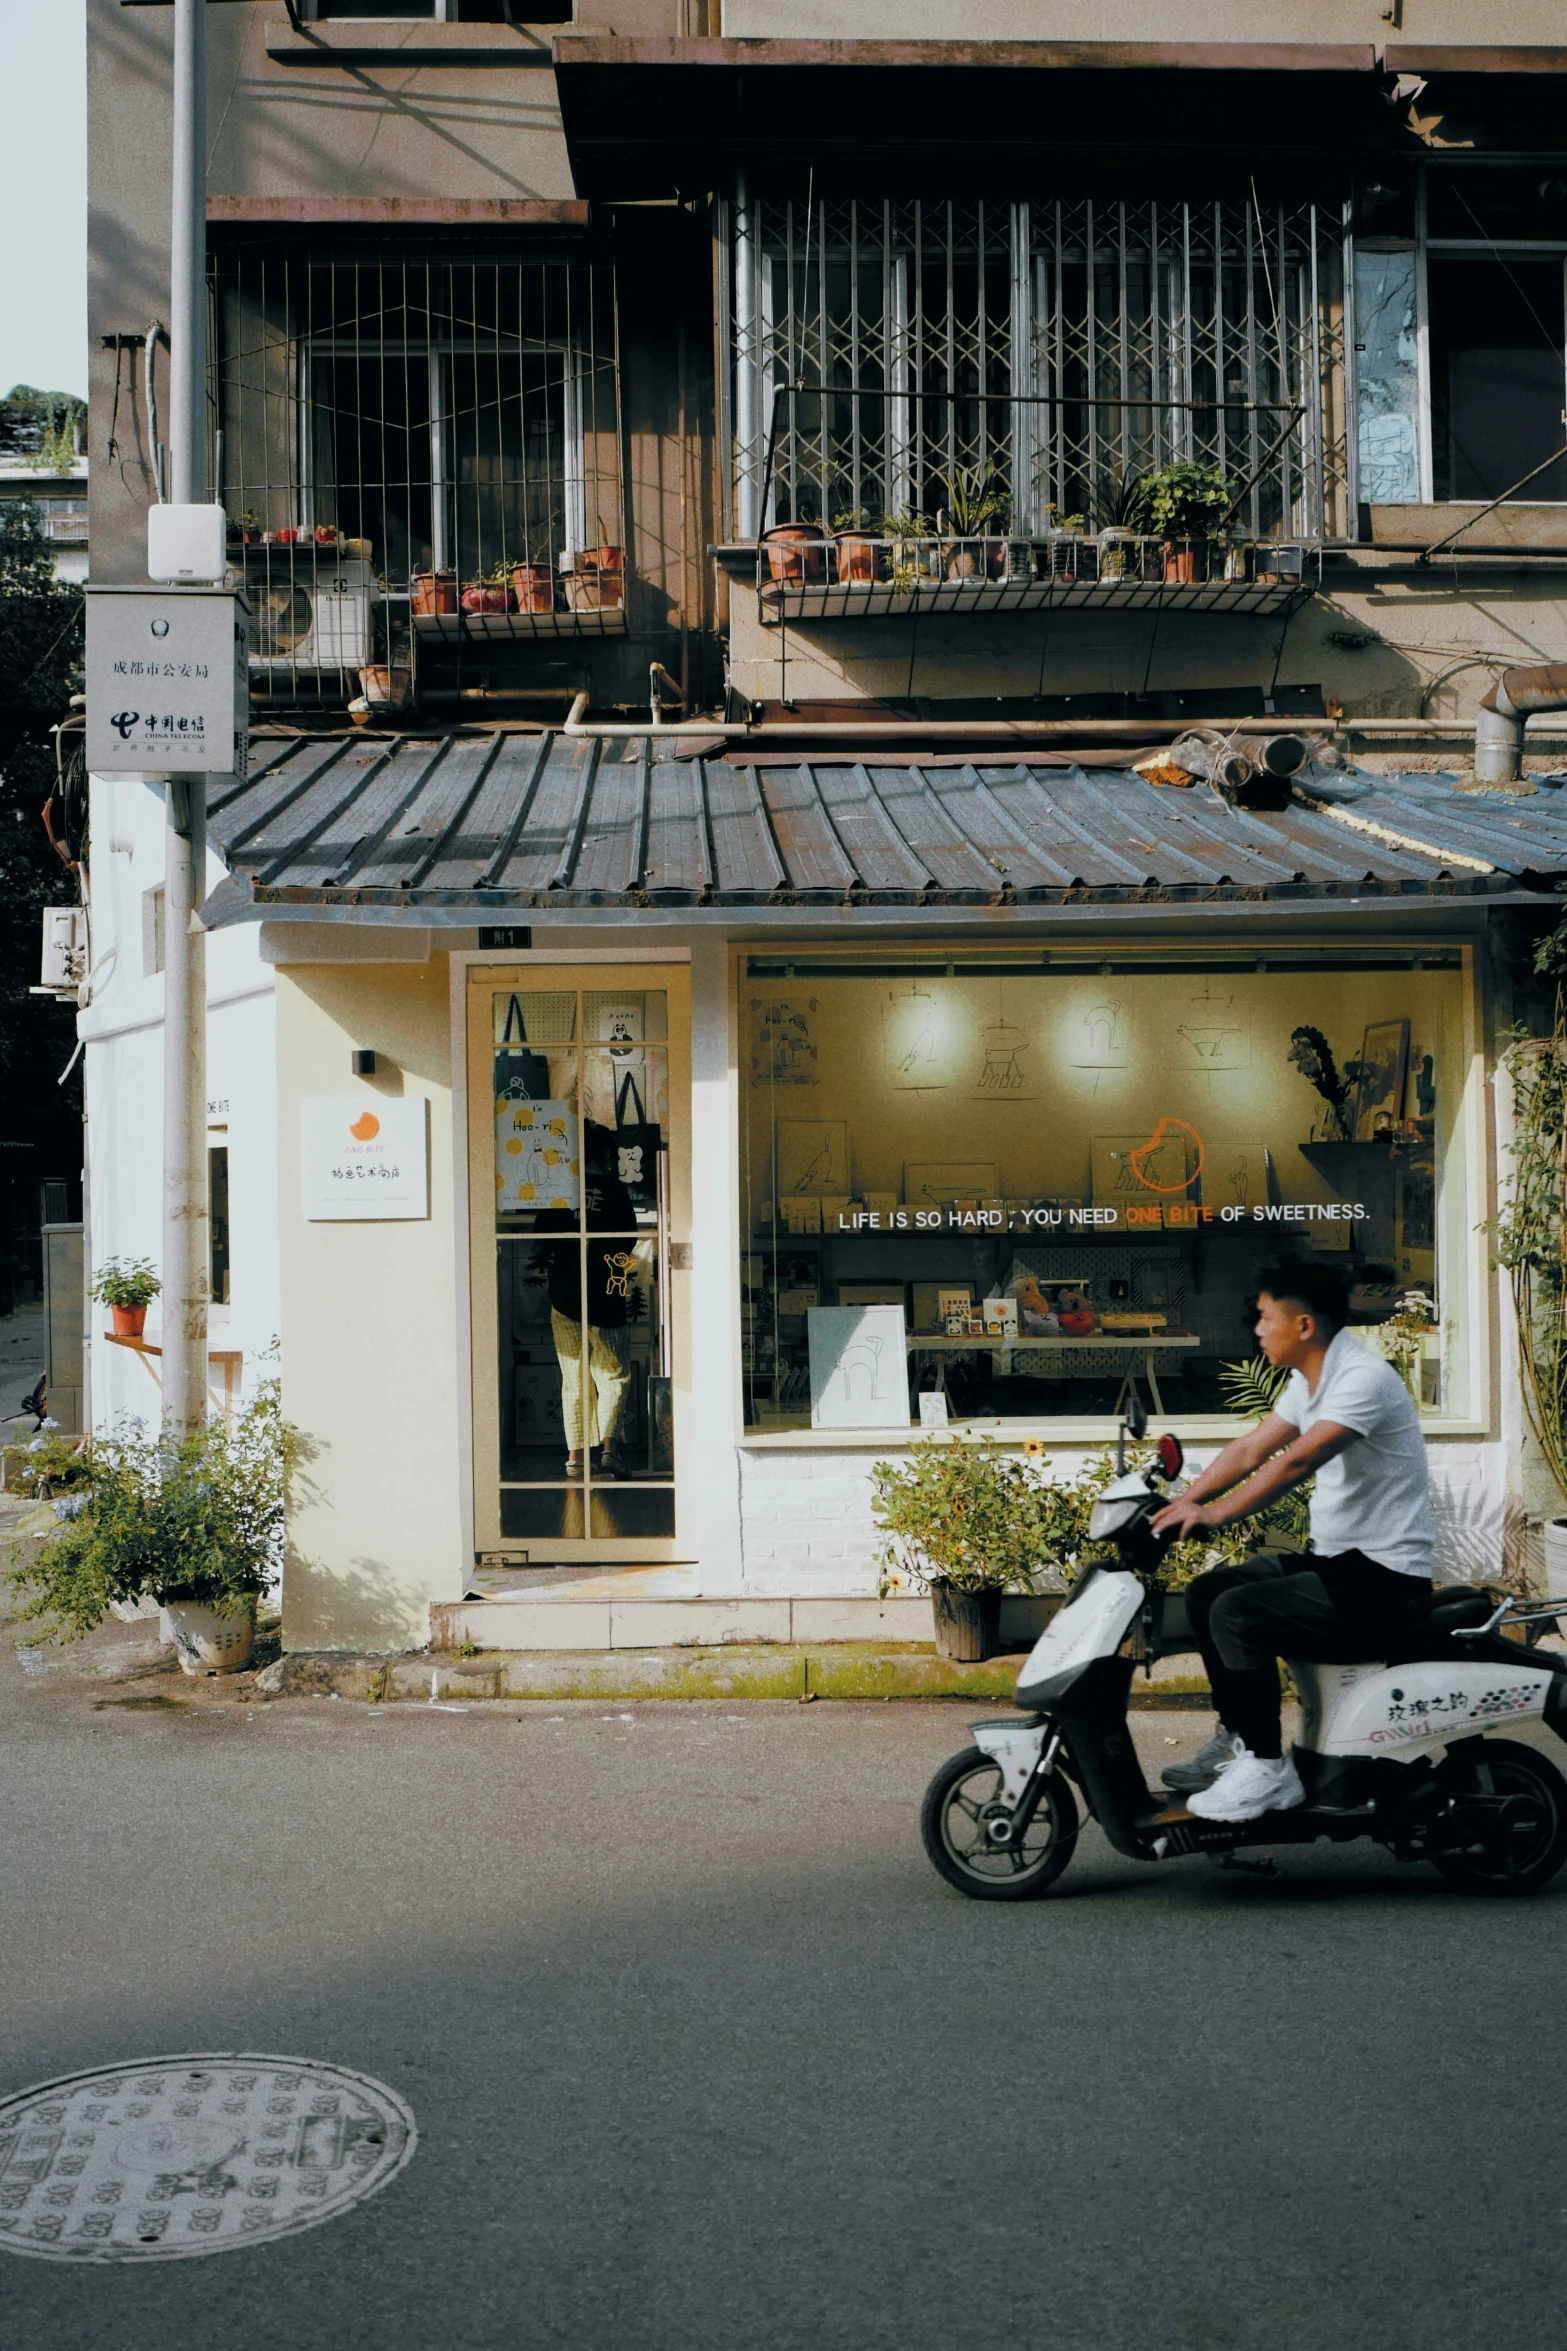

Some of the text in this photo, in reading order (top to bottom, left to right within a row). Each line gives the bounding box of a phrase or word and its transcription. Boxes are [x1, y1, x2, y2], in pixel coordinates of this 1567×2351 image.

[113, 661, 209, 679] 成都市公安局
[144, 714, 205, 732] 中国电信
[144, 732, 168, 740] CHINA
[344, 1145, 386, 1154] ONE BITE
[839, 1212, 880, 1229] LIFE
[889, 1212, 907, 1229] IS
[915, 1211, 941, 1228] SO
[949, 1210, 1002, 1227] HARD
[1021, 1209, 1062, 1225] YOU
[1069, 1208, 1118, 1224] NEED
[1125, 1206, 1162, 1223] ONE
[1169, 1206, 1214, 1222] BITE
[1220, 1206, 1245, 1222] OF
[1253, 1203, 1371, 1222] SWEETNESS.
